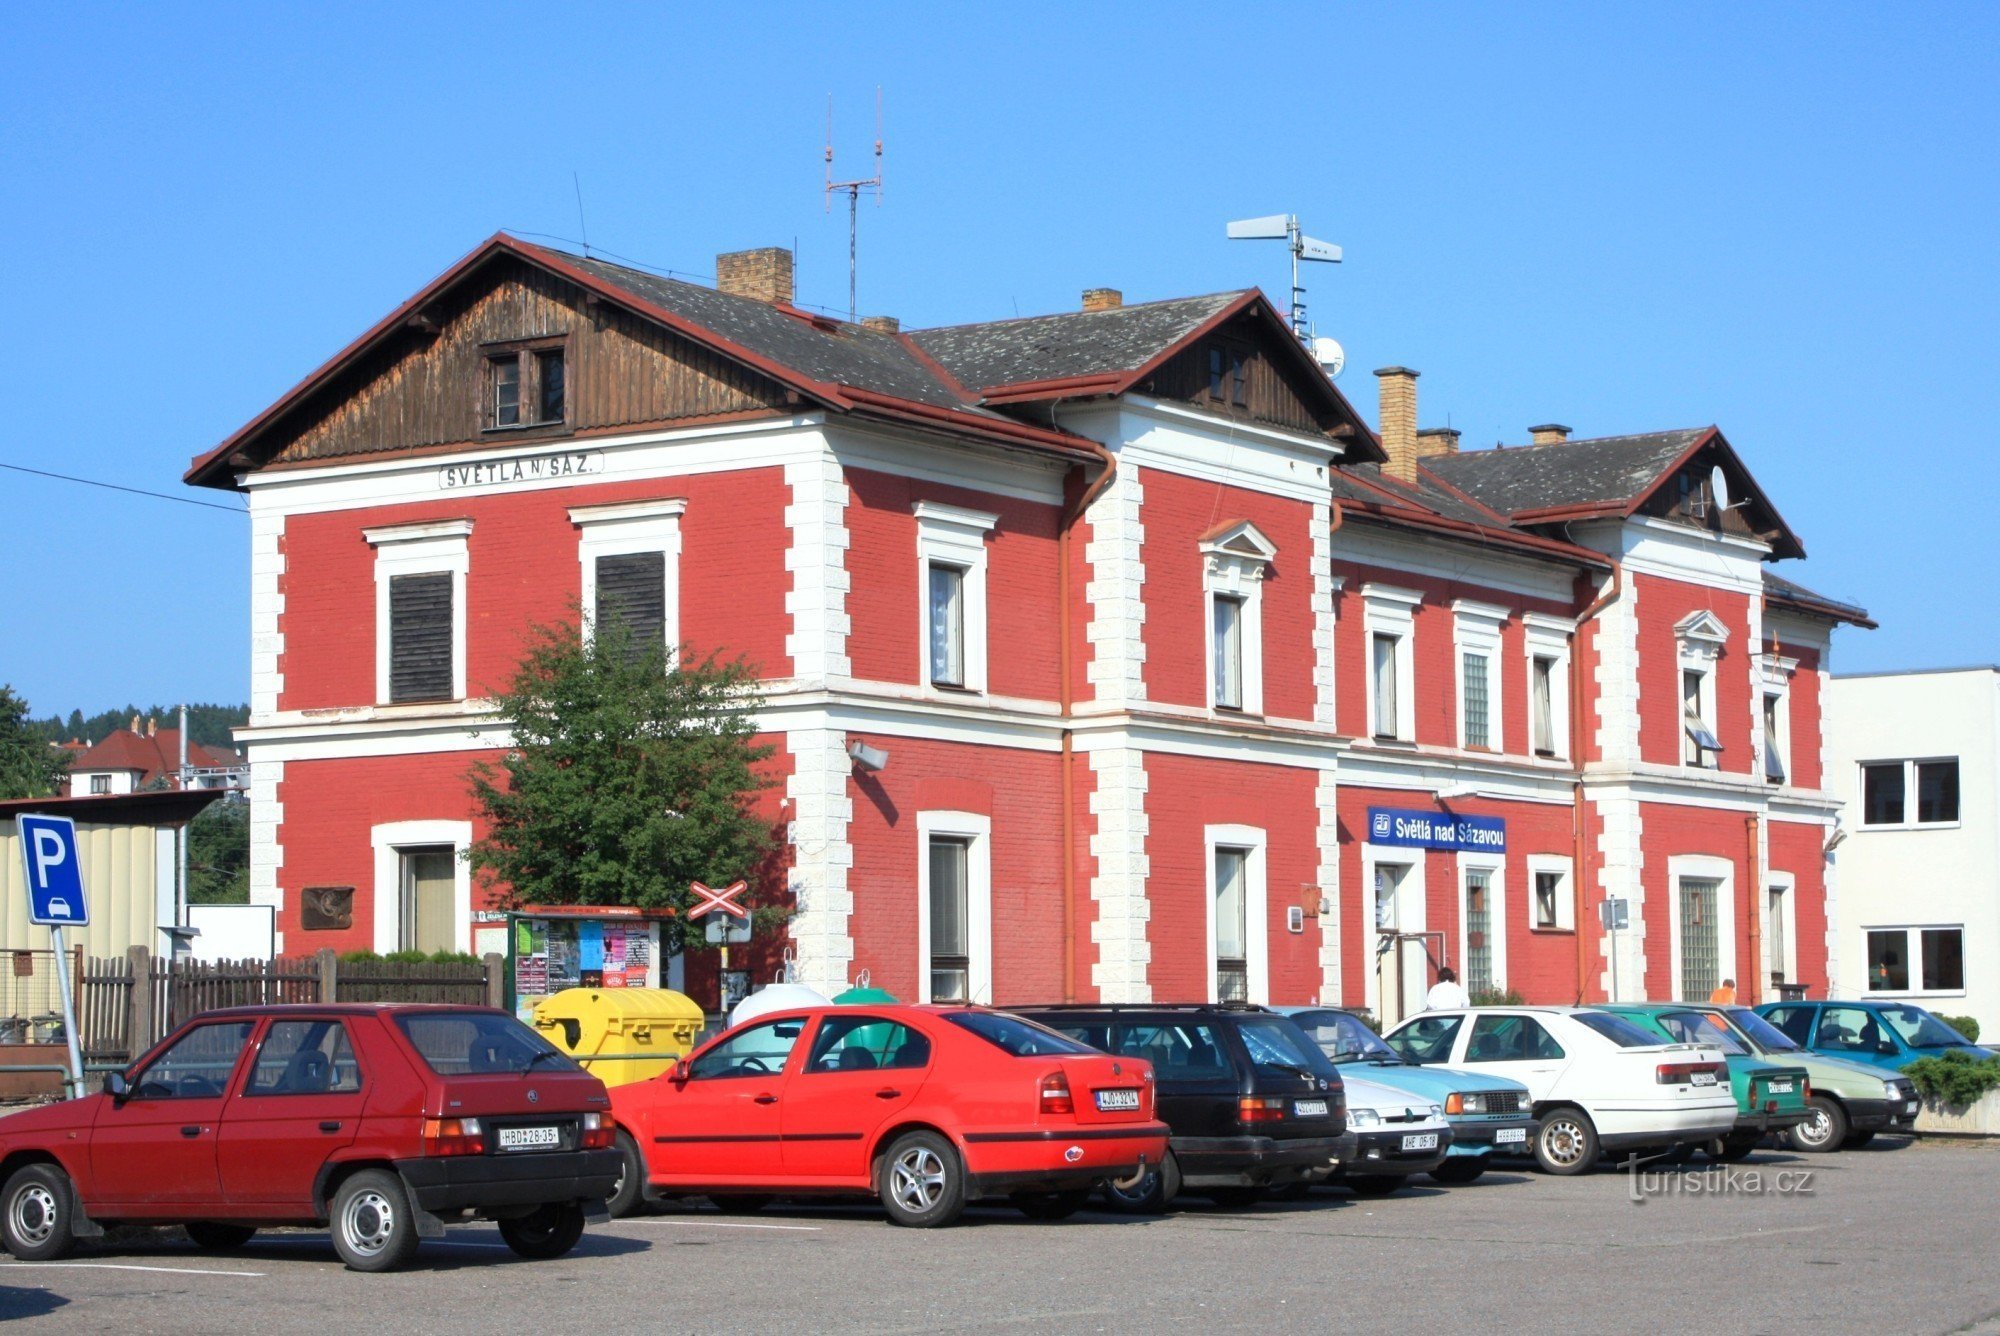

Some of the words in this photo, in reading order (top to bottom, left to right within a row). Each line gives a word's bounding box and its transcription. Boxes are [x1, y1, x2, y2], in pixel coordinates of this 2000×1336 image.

[1396, 817, 1431, 840] Světlá
[1435, 823, 1455, 842] nad
[1458, 823, 1504, 846] Sázavou
[33, 828, 66, 888] P
[504, 1130, 522, 1144] HBD
